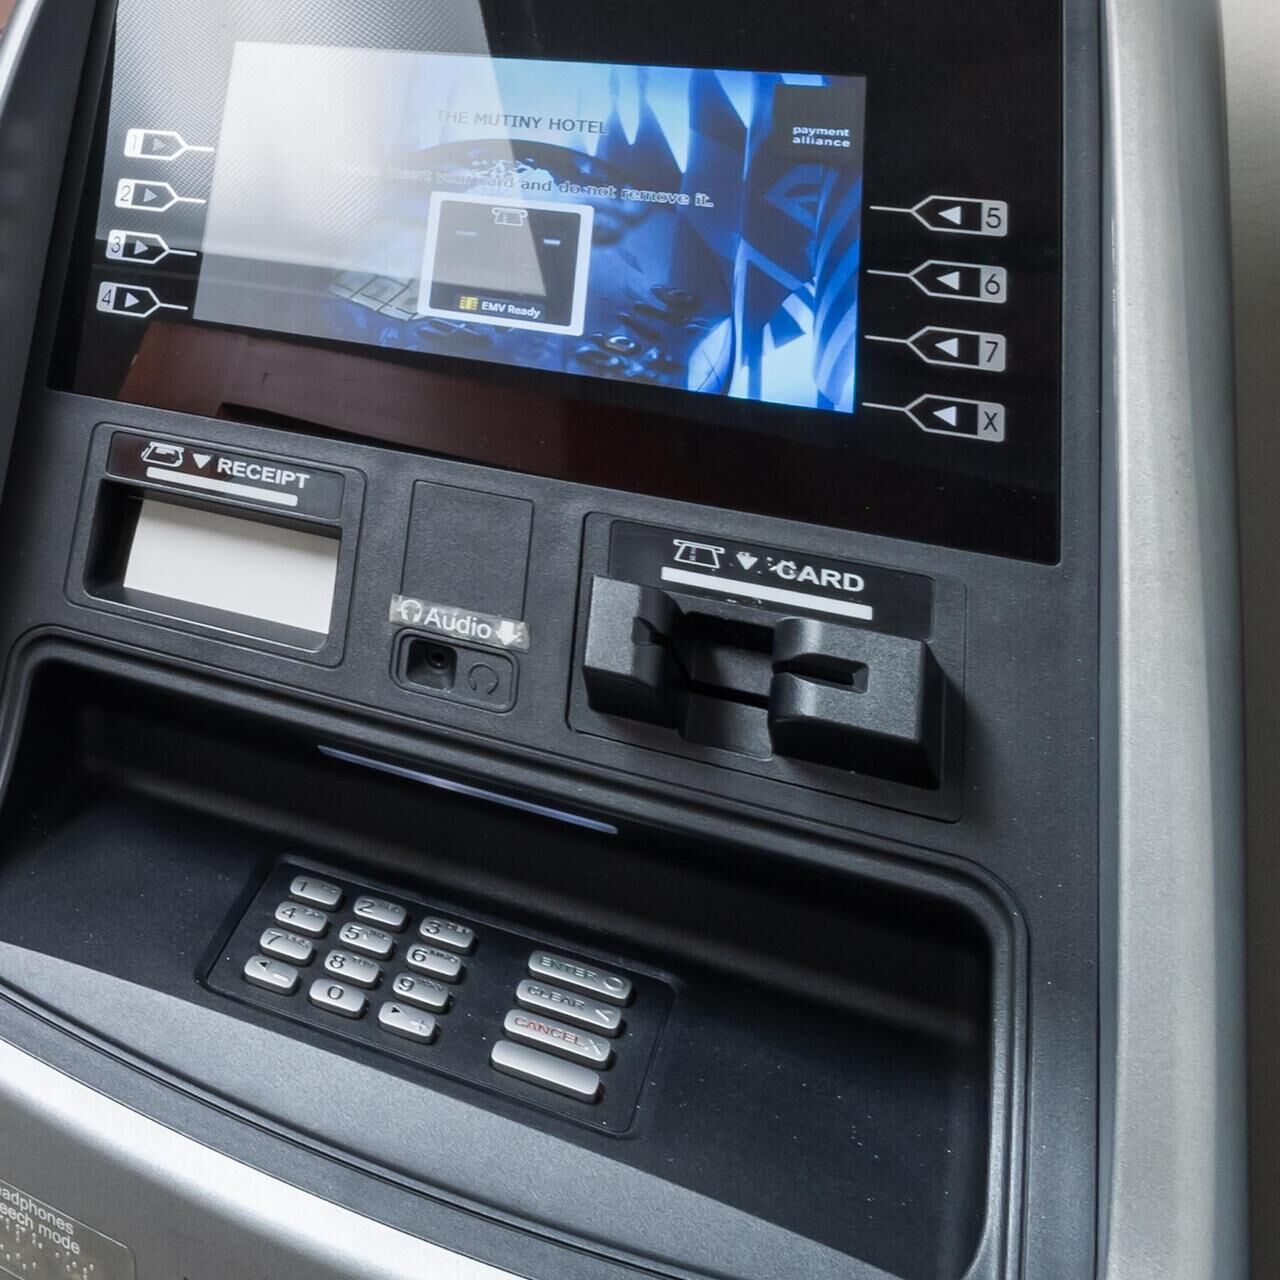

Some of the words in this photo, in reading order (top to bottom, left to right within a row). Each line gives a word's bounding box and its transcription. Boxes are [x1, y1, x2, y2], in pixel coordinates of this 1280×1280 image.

[436, 109, 468, 126] THE
[474, 112, 542, 130] MUTINY
[548, 116, 608, 135] HOTEL
[792, 126, 850, 138] payment
[792, 136, 851, 148] alliance
[119, 184, 132, 202] 2
[520, 177, 553, 193] and
[558, 179, 580, 196] do
[583, 183, 617, 200] not
[620, 187, 691, 206] remove
[985, 207, 1002, 229] 5
[110, 235, 122, 254] 3
[984, 273, 1001, 295] 6
[101, 288, 113, 306] 4
[481, 301, 507, 313] EMV
[507, 305, 541, 320] Ready
[985, 340, 999, 363] 7
[216, 457, 310, 489] RECEIPT
[775, 559, 865, 592] CARD
[424, 608, 492, 639] Audio
[298, 880, 307, 892] 1
[281, 906, 297, 919] 4
[357, 899, 376, 914] 2
[345, 924, 360, 940] 5
[425, 920, 442, 935] 3
[266, 931, 283, 945] 7
[329, 954, 346, 969] 8
[411, 948, 428, 962] 6
[540, 956, 598, 983] ENTER
[398, 976, 415, 991] 9
[528, 984, 585, 1010] CLEAR
[514, 1016, 585, 1047] CANCEL
[38, 1223, 81, 1255] mode
